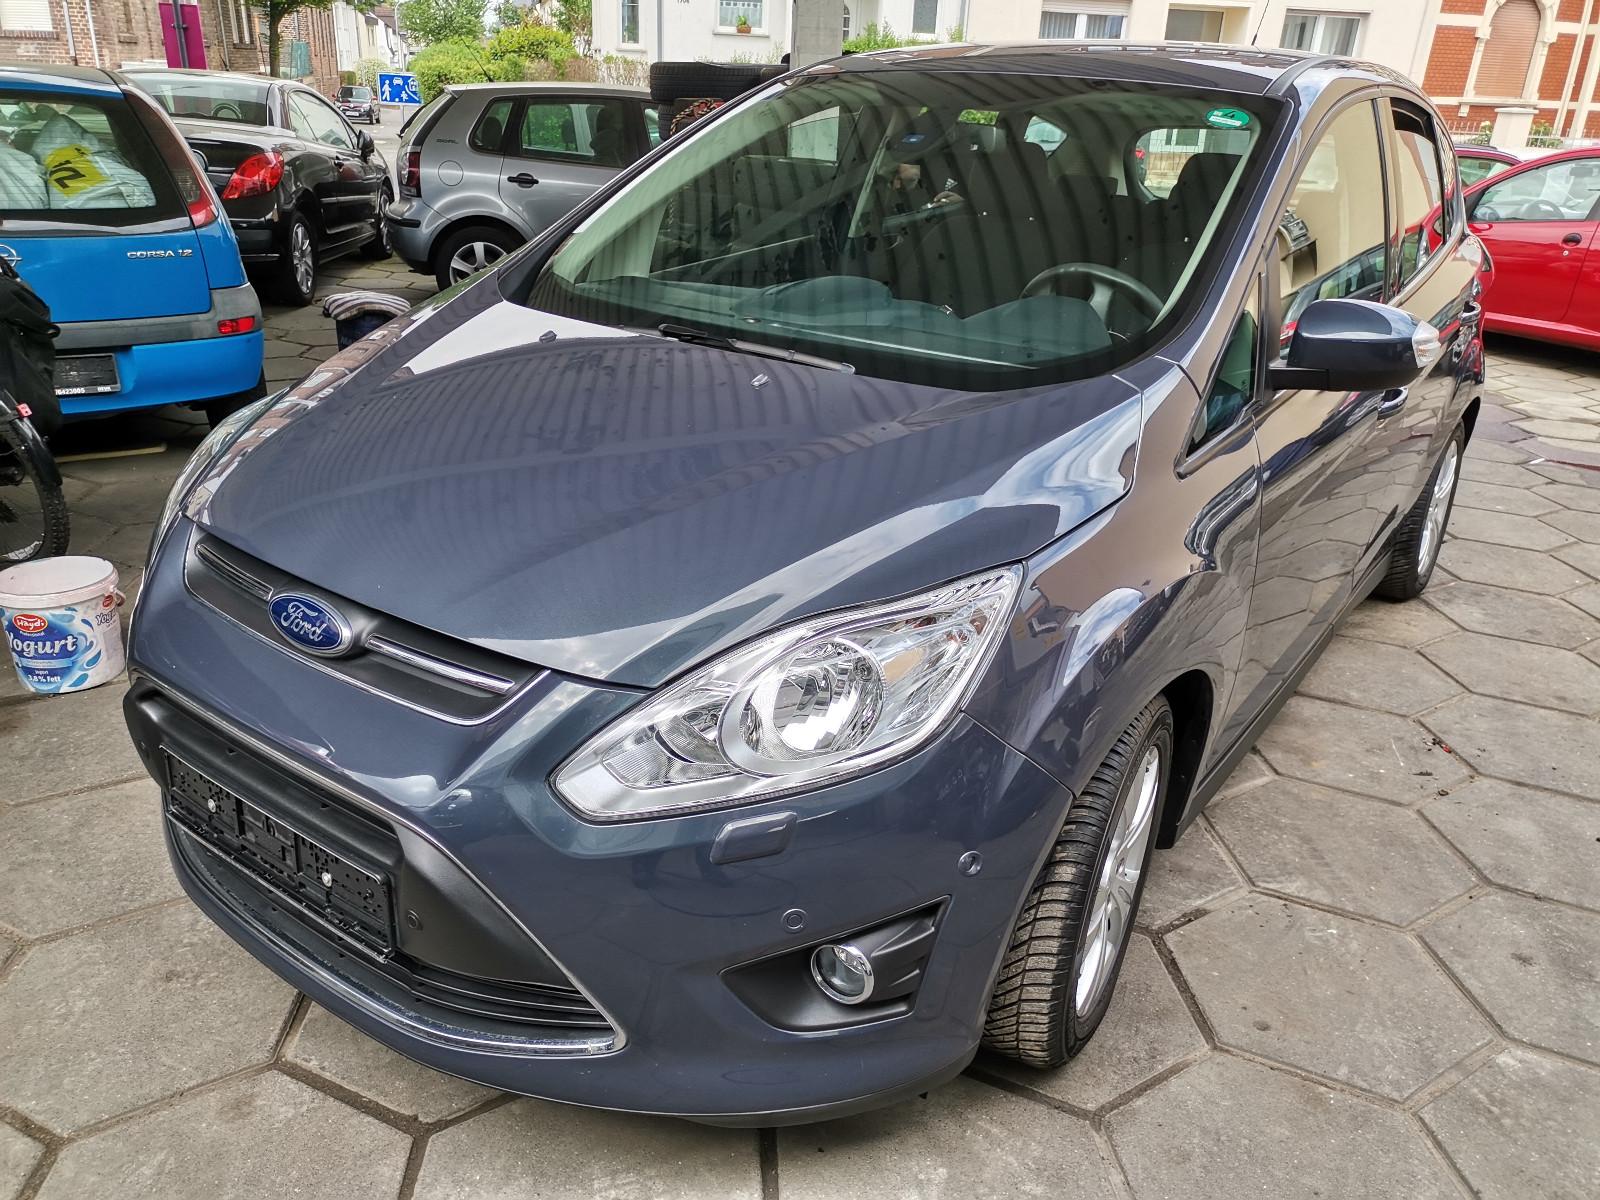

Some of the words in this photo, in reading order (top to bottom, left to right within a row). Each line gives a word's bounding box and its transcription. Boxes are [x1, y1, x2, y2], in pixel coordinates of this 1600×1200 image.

[127, 249, 175, 259] CORSA
[281, 603, 328, 641] Ford
[6, 631, 78, 657] Yogurt
